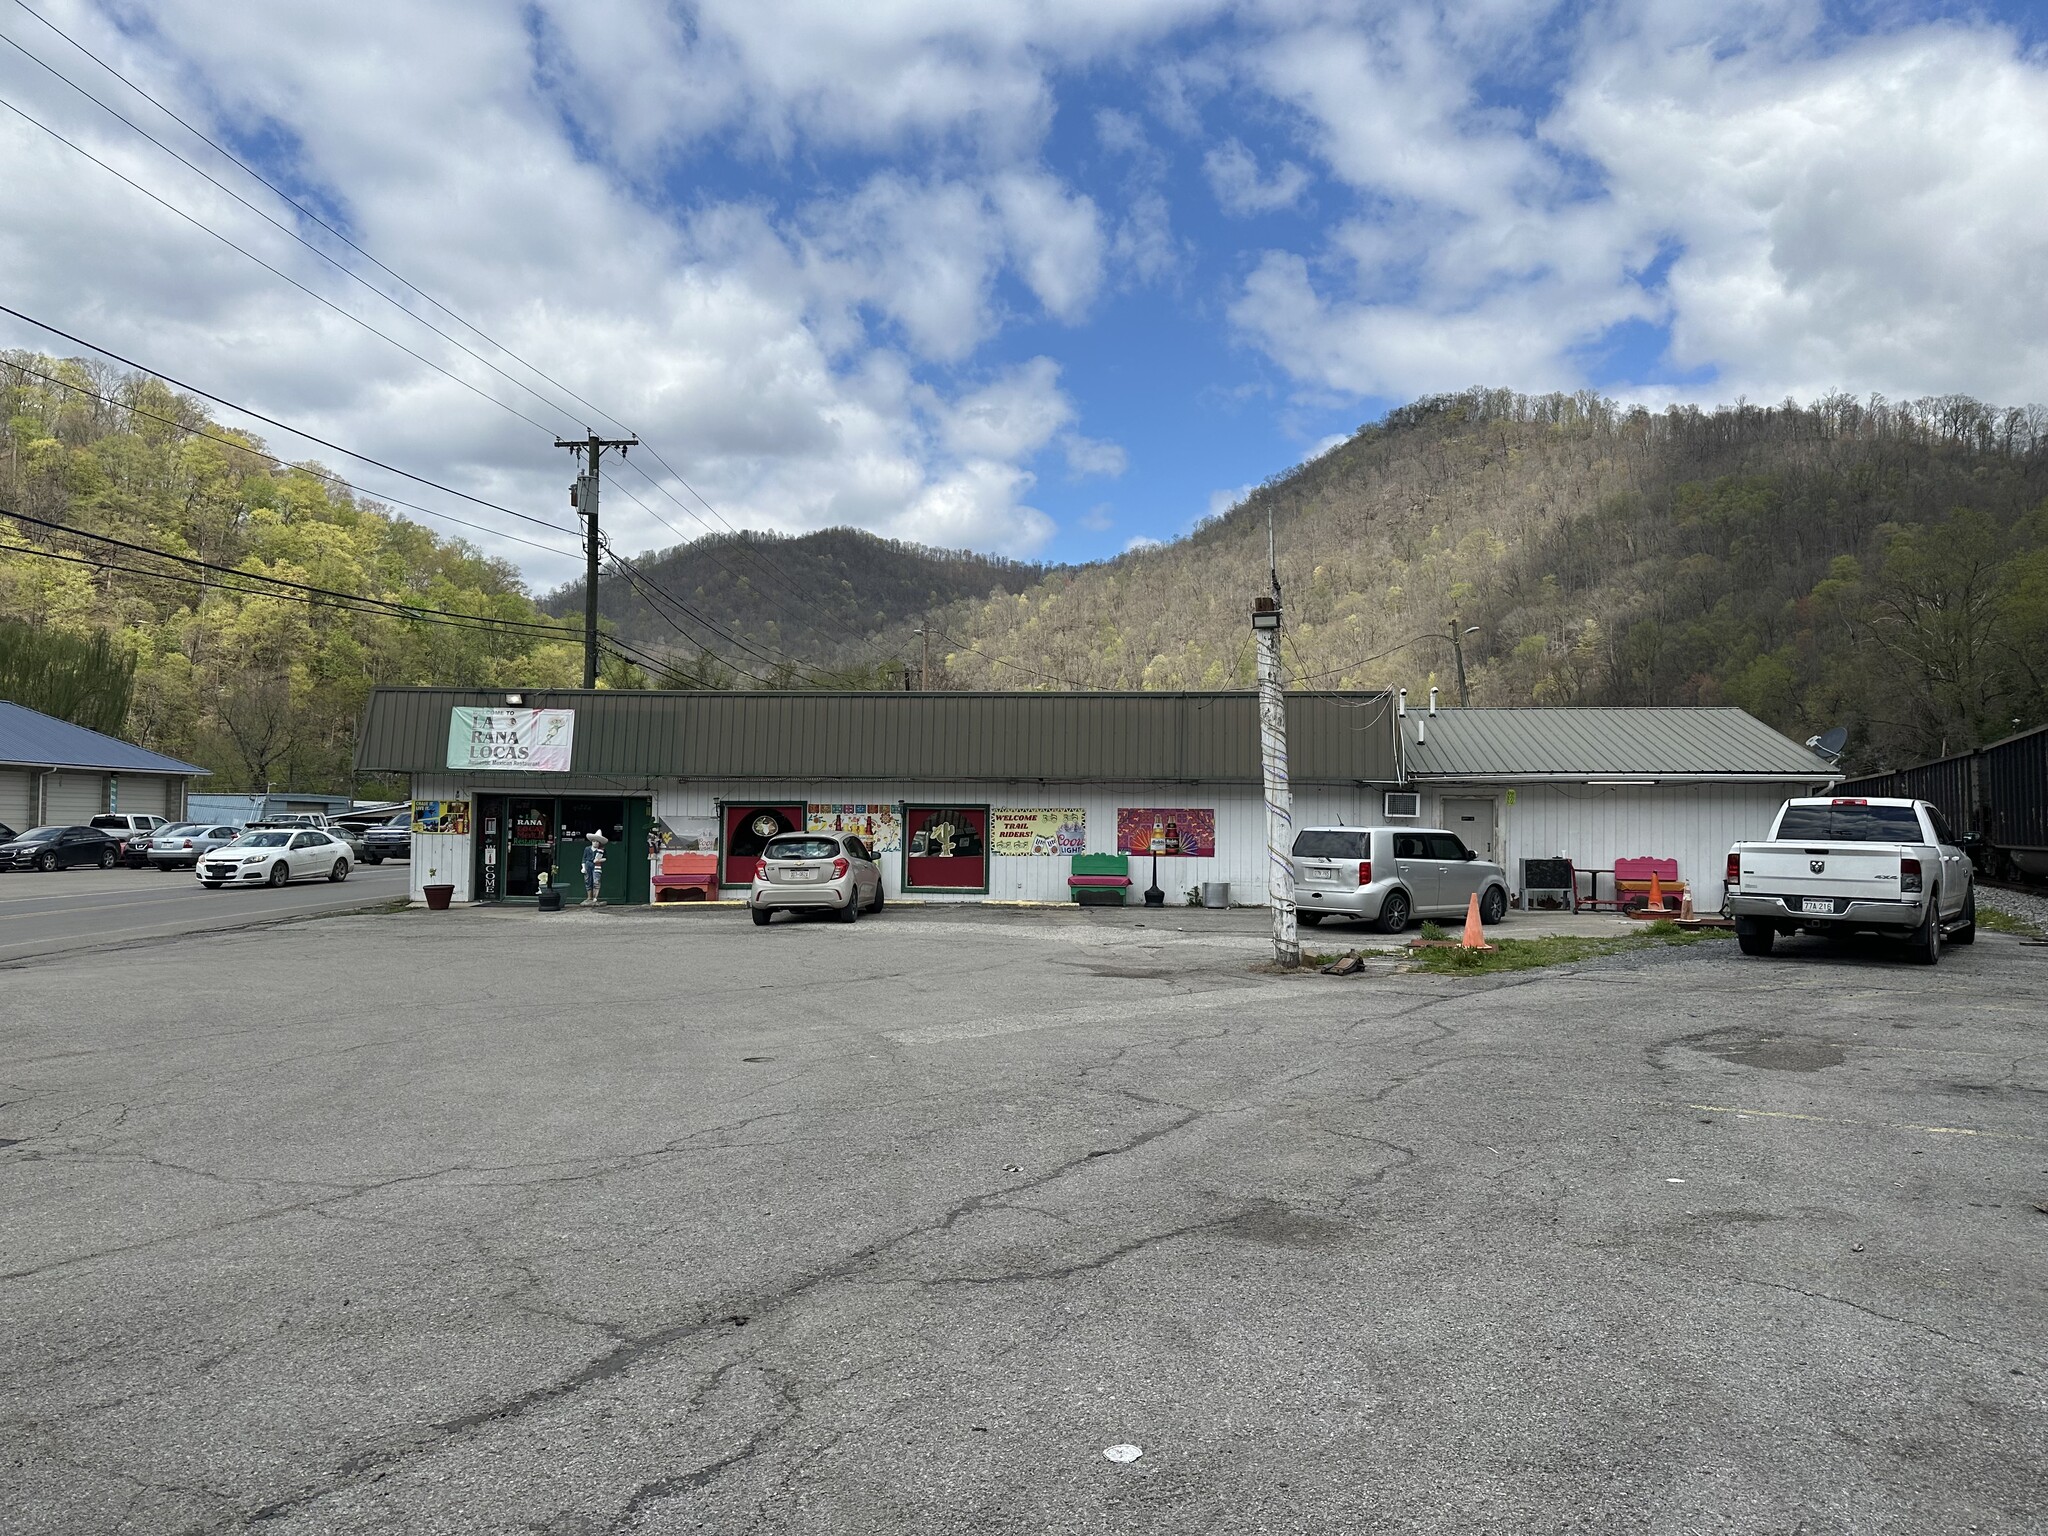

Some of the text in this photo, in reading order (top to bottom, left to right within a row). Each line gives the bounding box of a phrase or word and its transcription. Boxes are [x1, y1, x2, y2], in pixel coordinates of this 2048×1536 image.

[472, 716, 495, 729] LA
[471, 731, 519, 745] RANA
[470, 745, 529, 760] LOCAS
[999, 830, 1033, 838] RIDERS!
